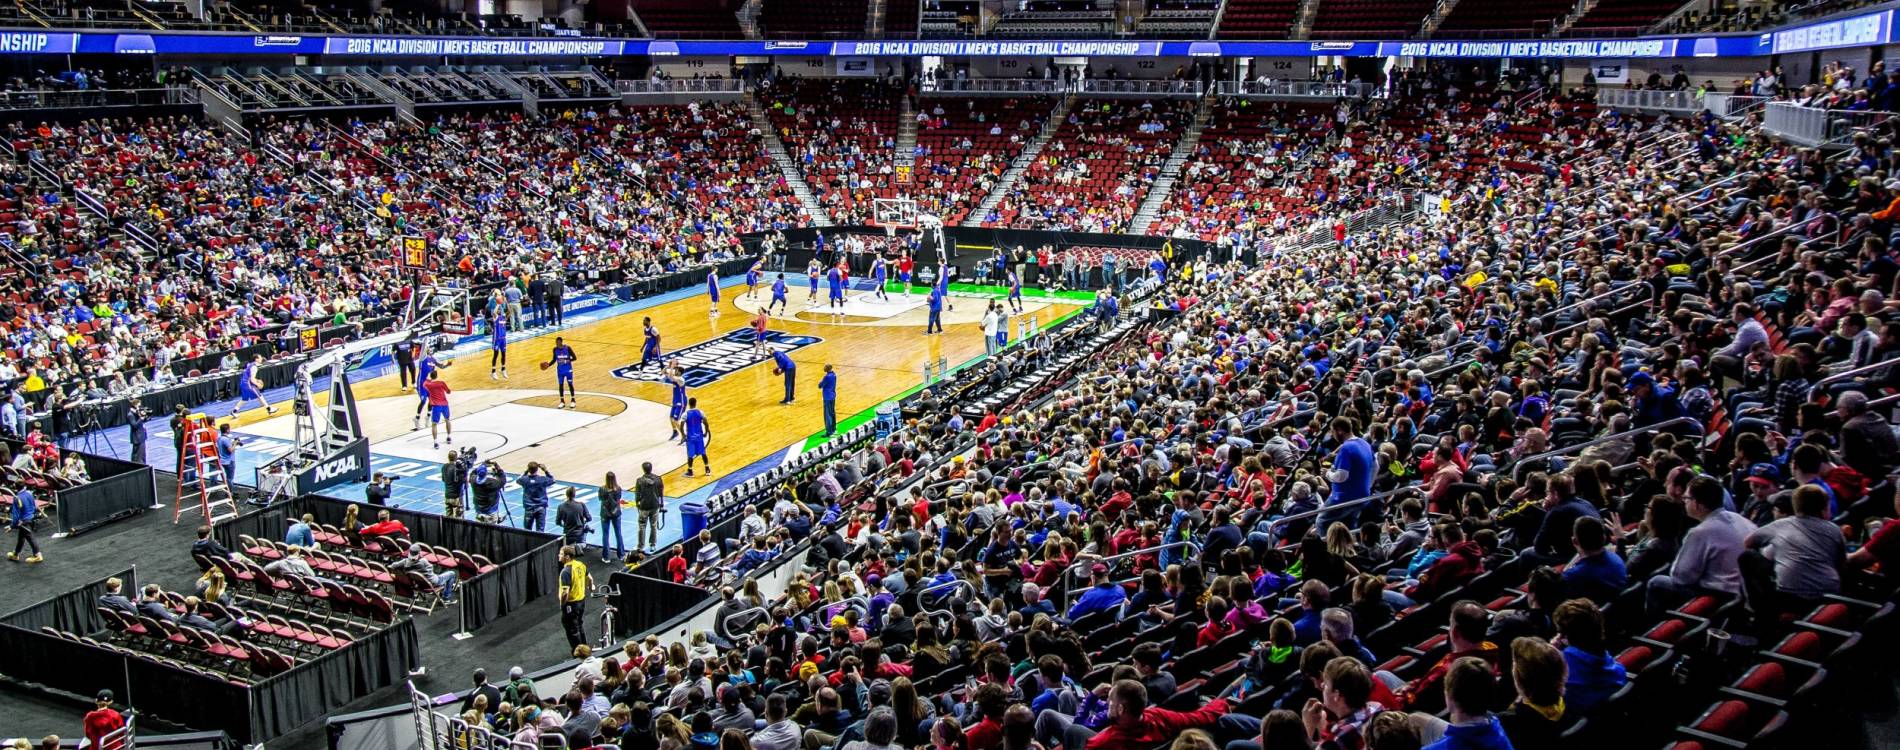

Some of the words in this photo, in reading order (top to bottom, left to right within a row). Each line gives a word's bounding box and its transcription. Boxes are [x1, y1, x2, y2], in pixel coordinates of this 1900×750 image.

[1, 33, 47, 51] NSHIP
[348, 39, 371, 53] 2016
[373, 39, 396, 53] NCAA
[399, 40, 437, 53] DIVISION
[438, 40, 443, 53] I
[444, 40, 469, 53] MEN'S
[471, 40, 526, 54] BASKETBALL
[528, 41, 604, 54] CHAMPIONSHIP
[855, 42, 880, 55] 2016
[882, 42, 909, 55] NCAA
[912, 42, 957, 55] DIVISION
[959, 42, 963, 55] I
[965, 42, 998, 55] MEN'S
[999, 42, 1059, 55] BASKETBALL
[1061, 42, 1139, 55] CHAMPIONSHIP
[1401, 43, 1427, 56] 2016
[1429, 43, 1458, 56] NCAA
[1460, 43, 1501, 56] DIVISION
[1509, 42, 1538, 56] MEN'S
[1539, 42, 1598, 56] BASKETBALL
[686, 59, 704, 68] 119
[1137, 60, 1155, 68] 122
[1273, 61, 1292, 69] 124
[571, 298, 598, 311] UNIVERSITY
[303, 337, 315, 349] 30
[380, 344, 393, 358] FIR
[314, 454, 356, 484] NCAA
